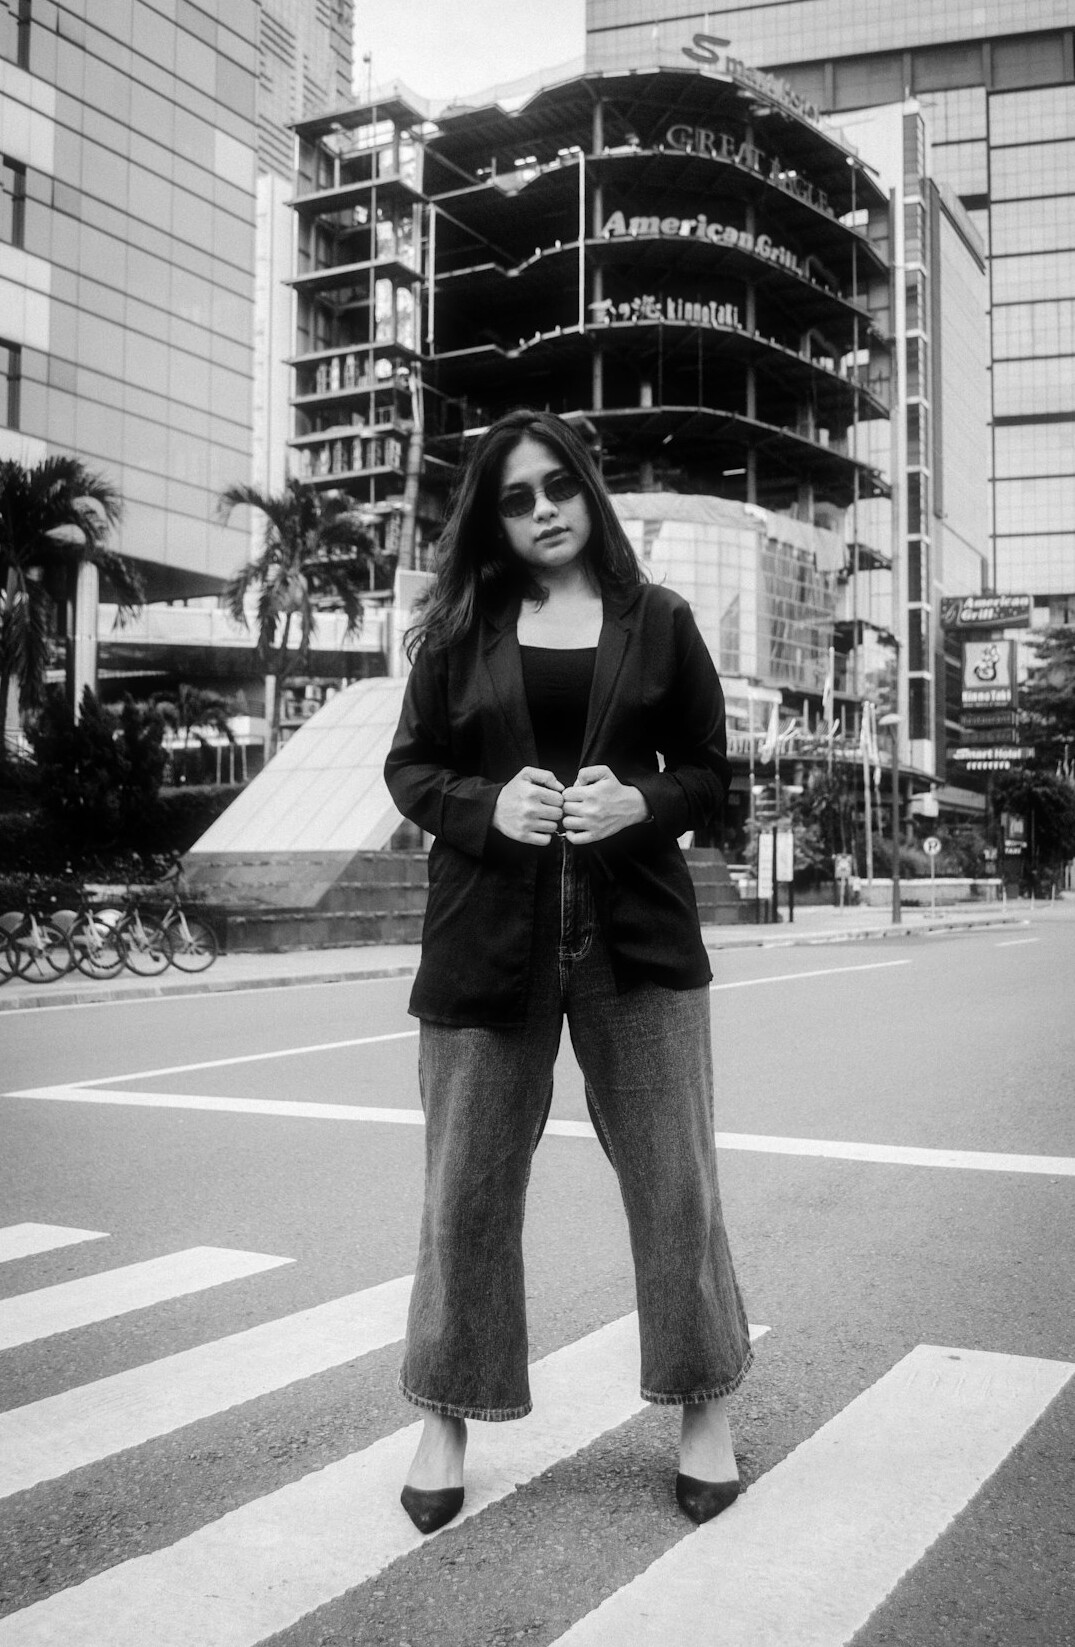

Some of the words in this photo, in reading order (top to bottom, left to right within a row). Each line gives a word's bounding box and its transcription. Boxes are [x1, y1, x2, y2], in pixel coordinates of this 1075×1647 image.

[666, 125, 765, 171] GREAT
[602, 211, 755, 252] American
[961, 608, 994, 621] Grill
[964, 595, 1029, 609] American
